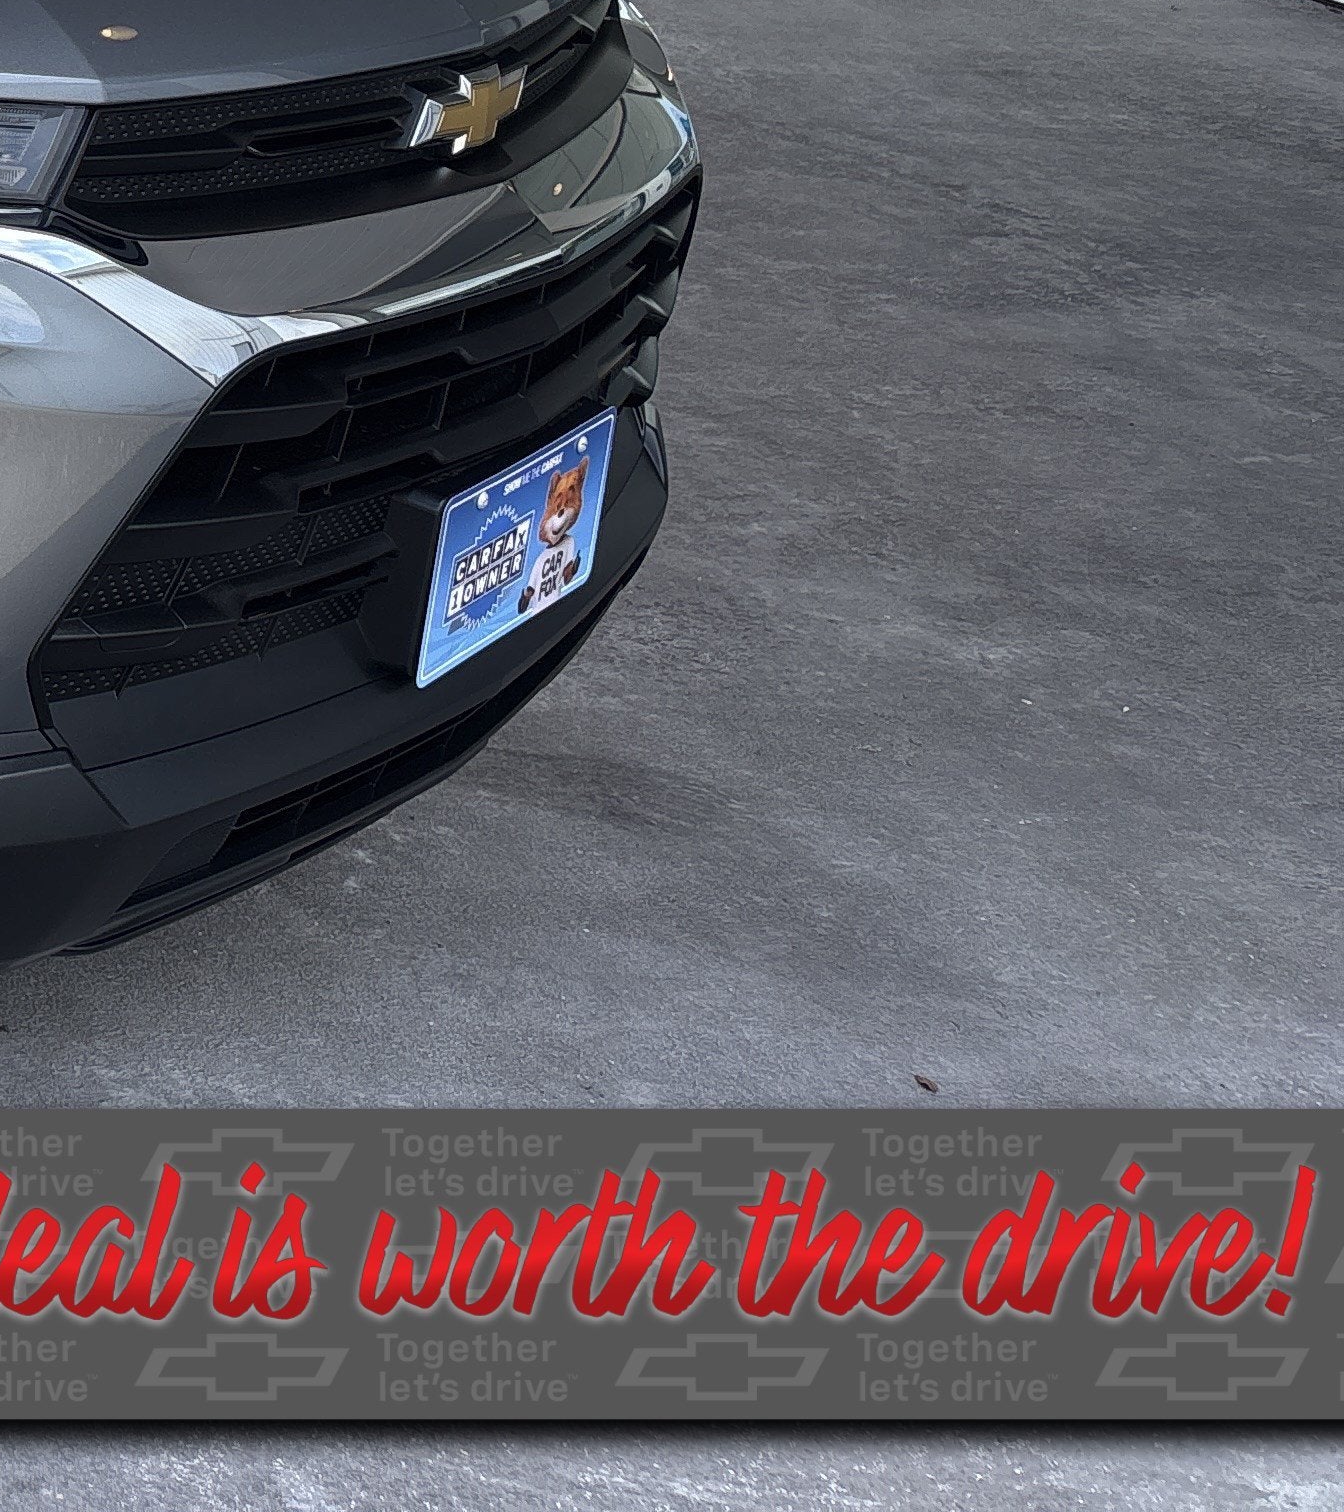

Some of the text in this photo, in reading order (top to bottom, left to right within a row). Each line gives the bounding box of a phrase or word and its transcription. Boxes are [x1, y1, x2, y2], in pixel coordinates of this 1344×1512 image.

[454, 528, 528, 582] CARFAX
[541, 550, 564, 580] CAR
[537, 572, 560, 603] FOX
